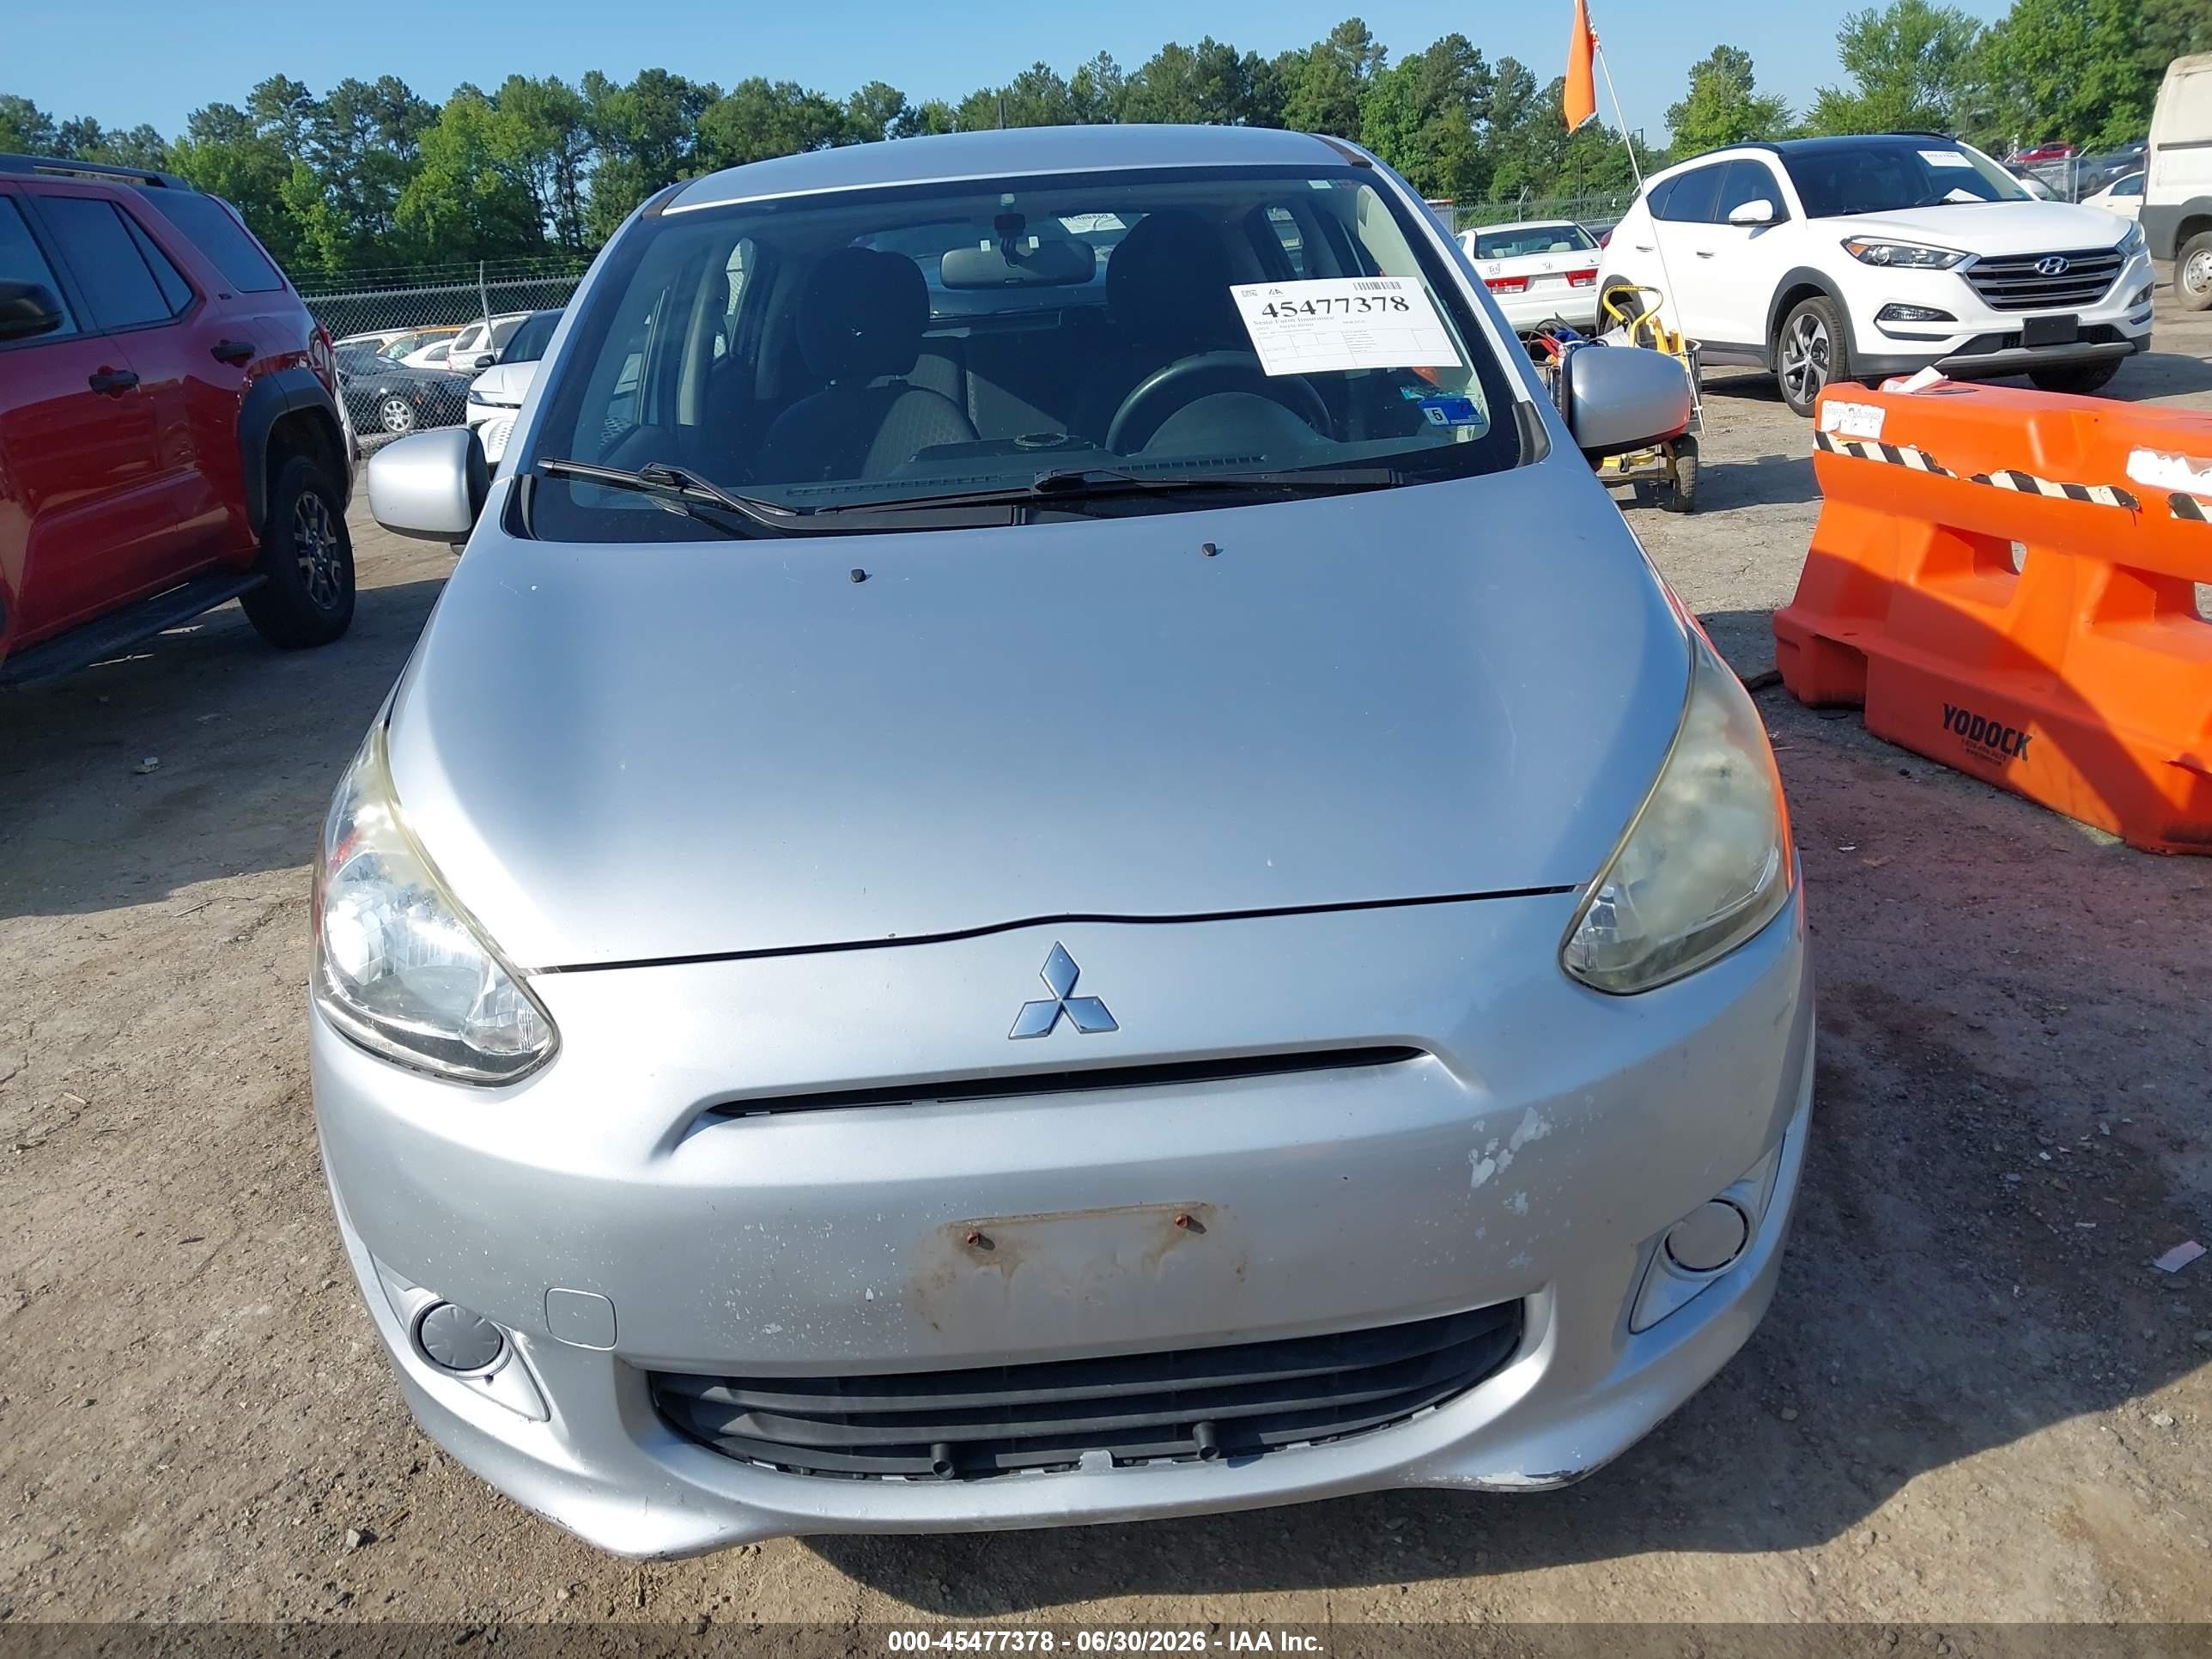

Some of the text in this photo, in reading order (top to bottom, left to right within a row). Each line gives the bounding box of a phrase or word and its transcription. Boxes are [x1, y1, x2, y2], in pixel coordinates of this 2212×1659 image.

[1261, 295, 1410, 319] 45477378
[1431, 409, 1443, 422] 5
[1942, 702, 2033, 762] YODOCK
